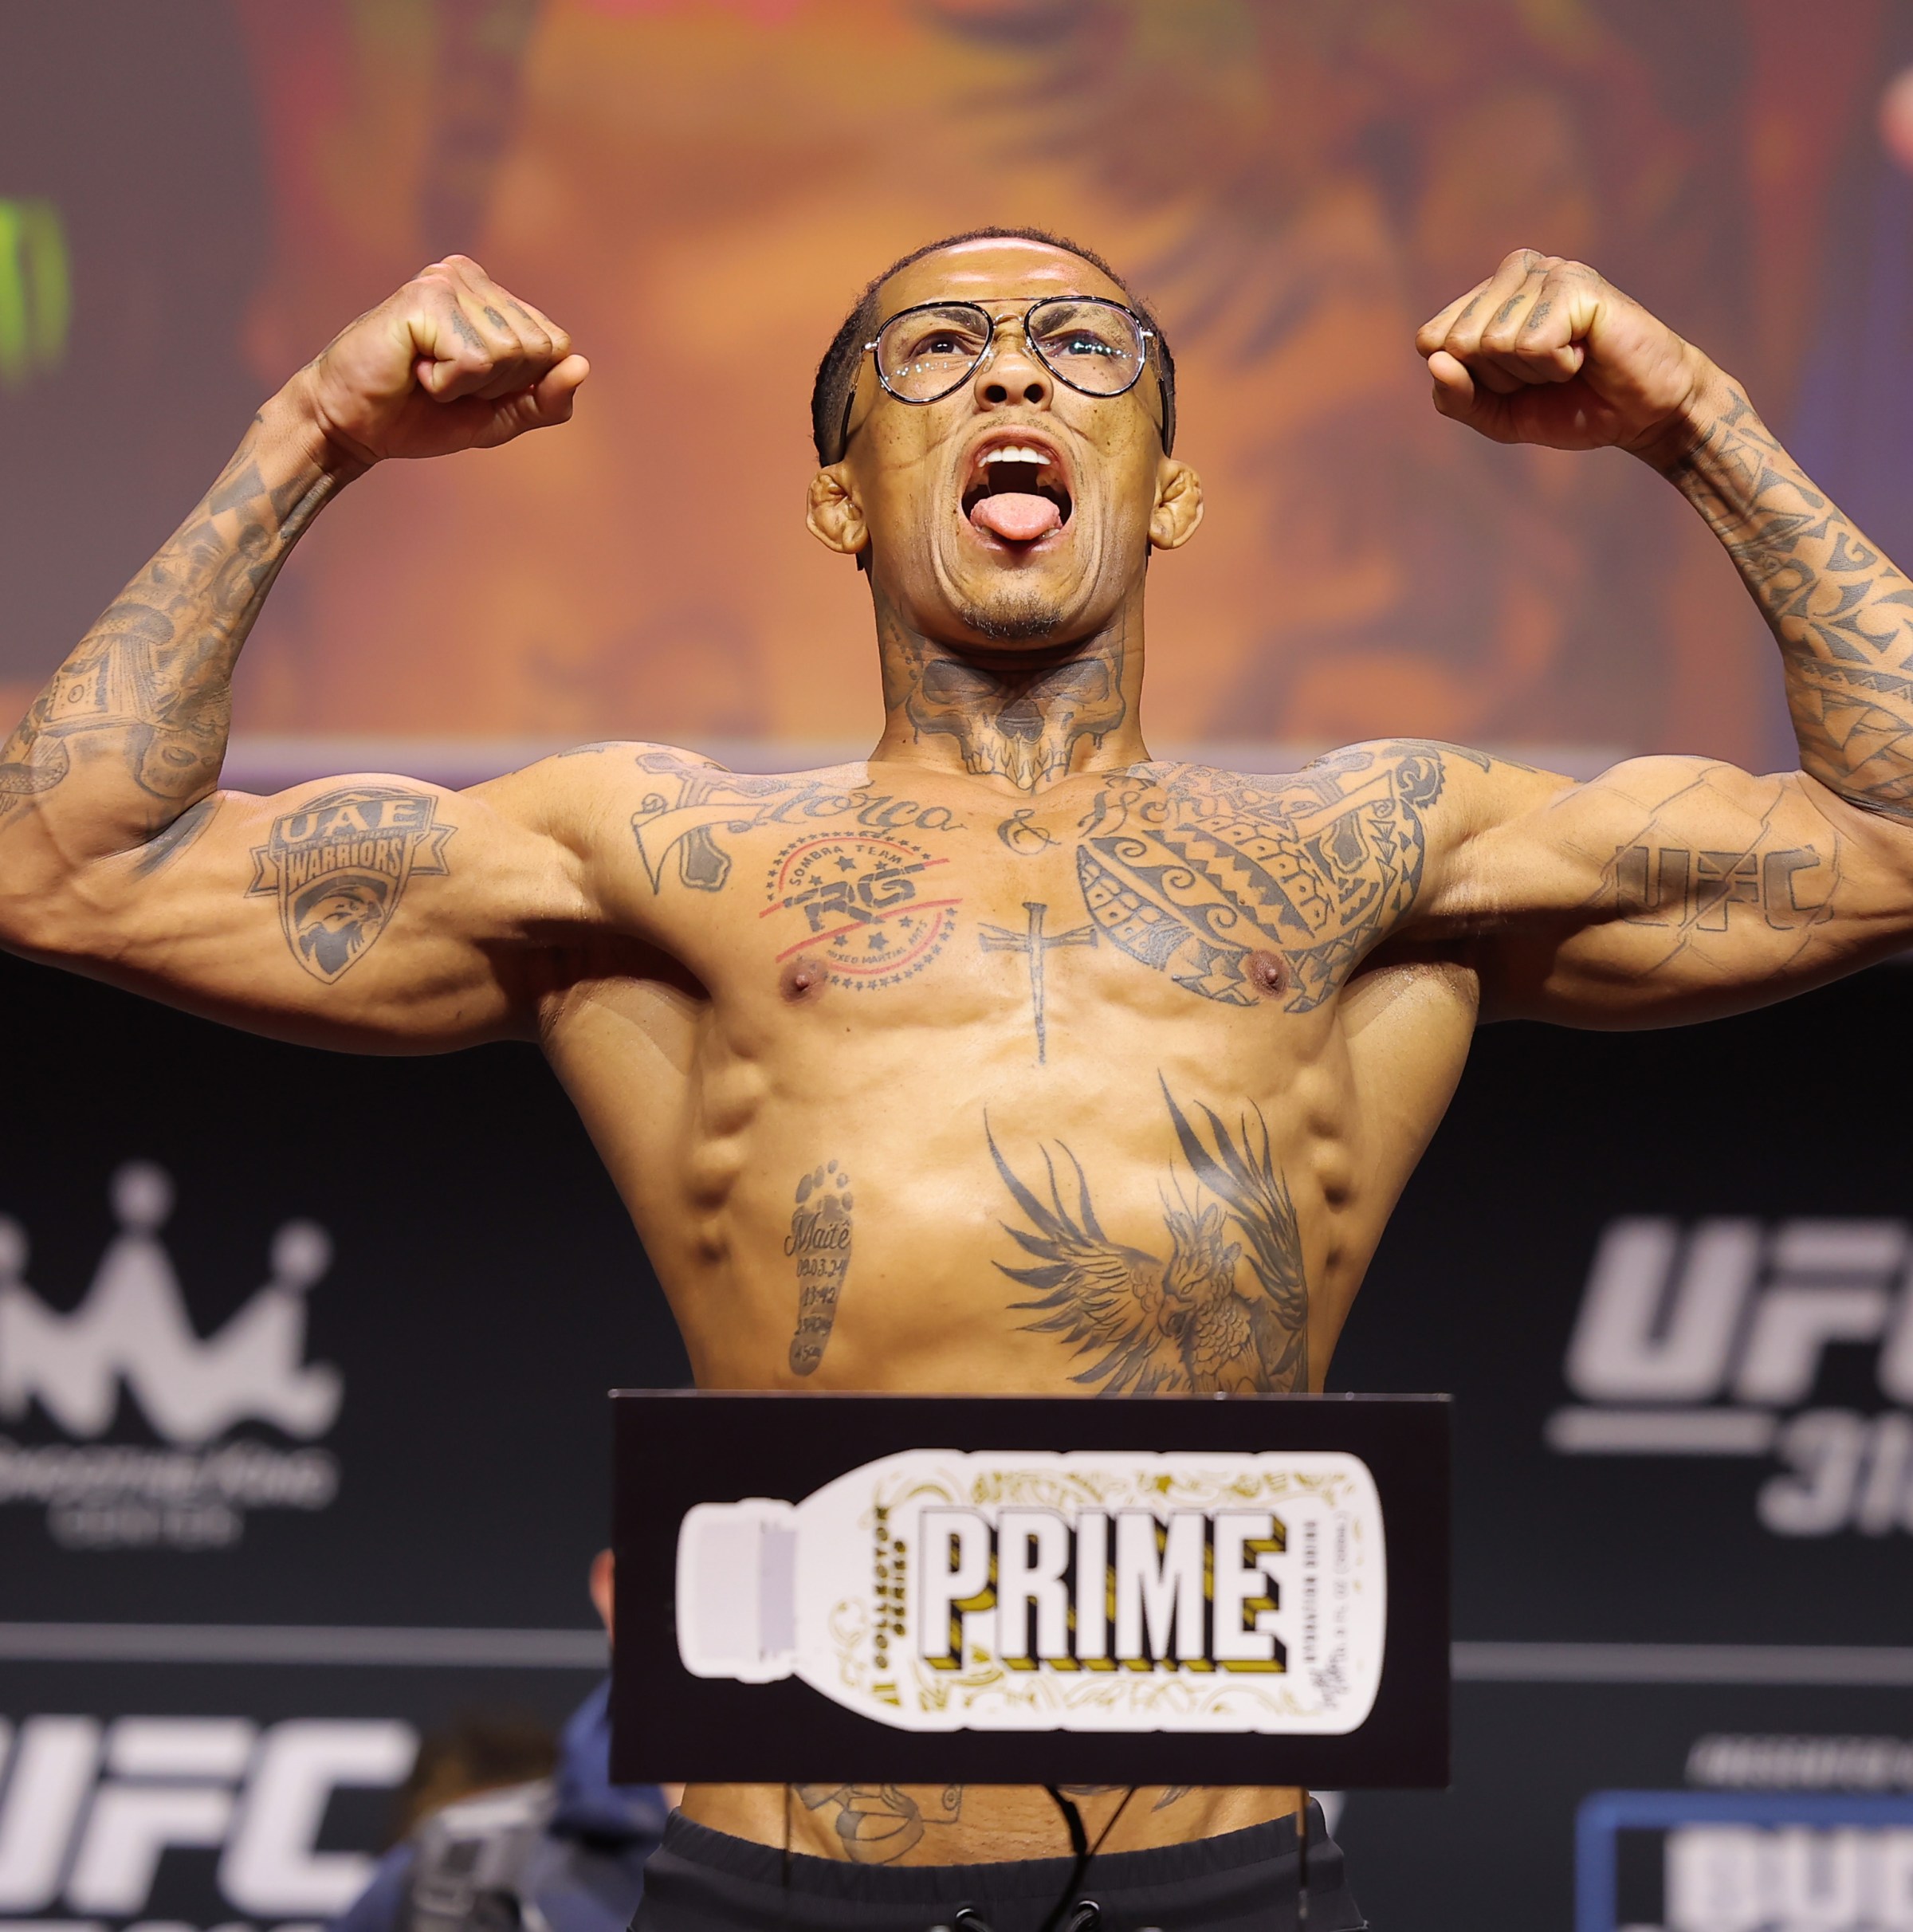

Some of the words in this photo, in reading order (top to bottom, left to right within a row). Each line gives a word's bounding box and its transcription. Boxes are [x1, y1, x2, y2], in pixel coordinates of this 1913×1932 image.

[280, 794, 419, 843] UAE
[997, 808, 1061, 855] &
[288, 837, 403, 887] WARRIORS
[788, 846, 843, 886] SOMBRA
[855, 844, 902, 864] TEAM
[1616, 845, 1834, 931] UFC
[784, 1211, 851, 1257] Maitê
[1565, 1216, 1913, 1401] UF
[1758, 1411, 1913, 1535] 31
[920, 1506, 1286, 1672] PRIME
